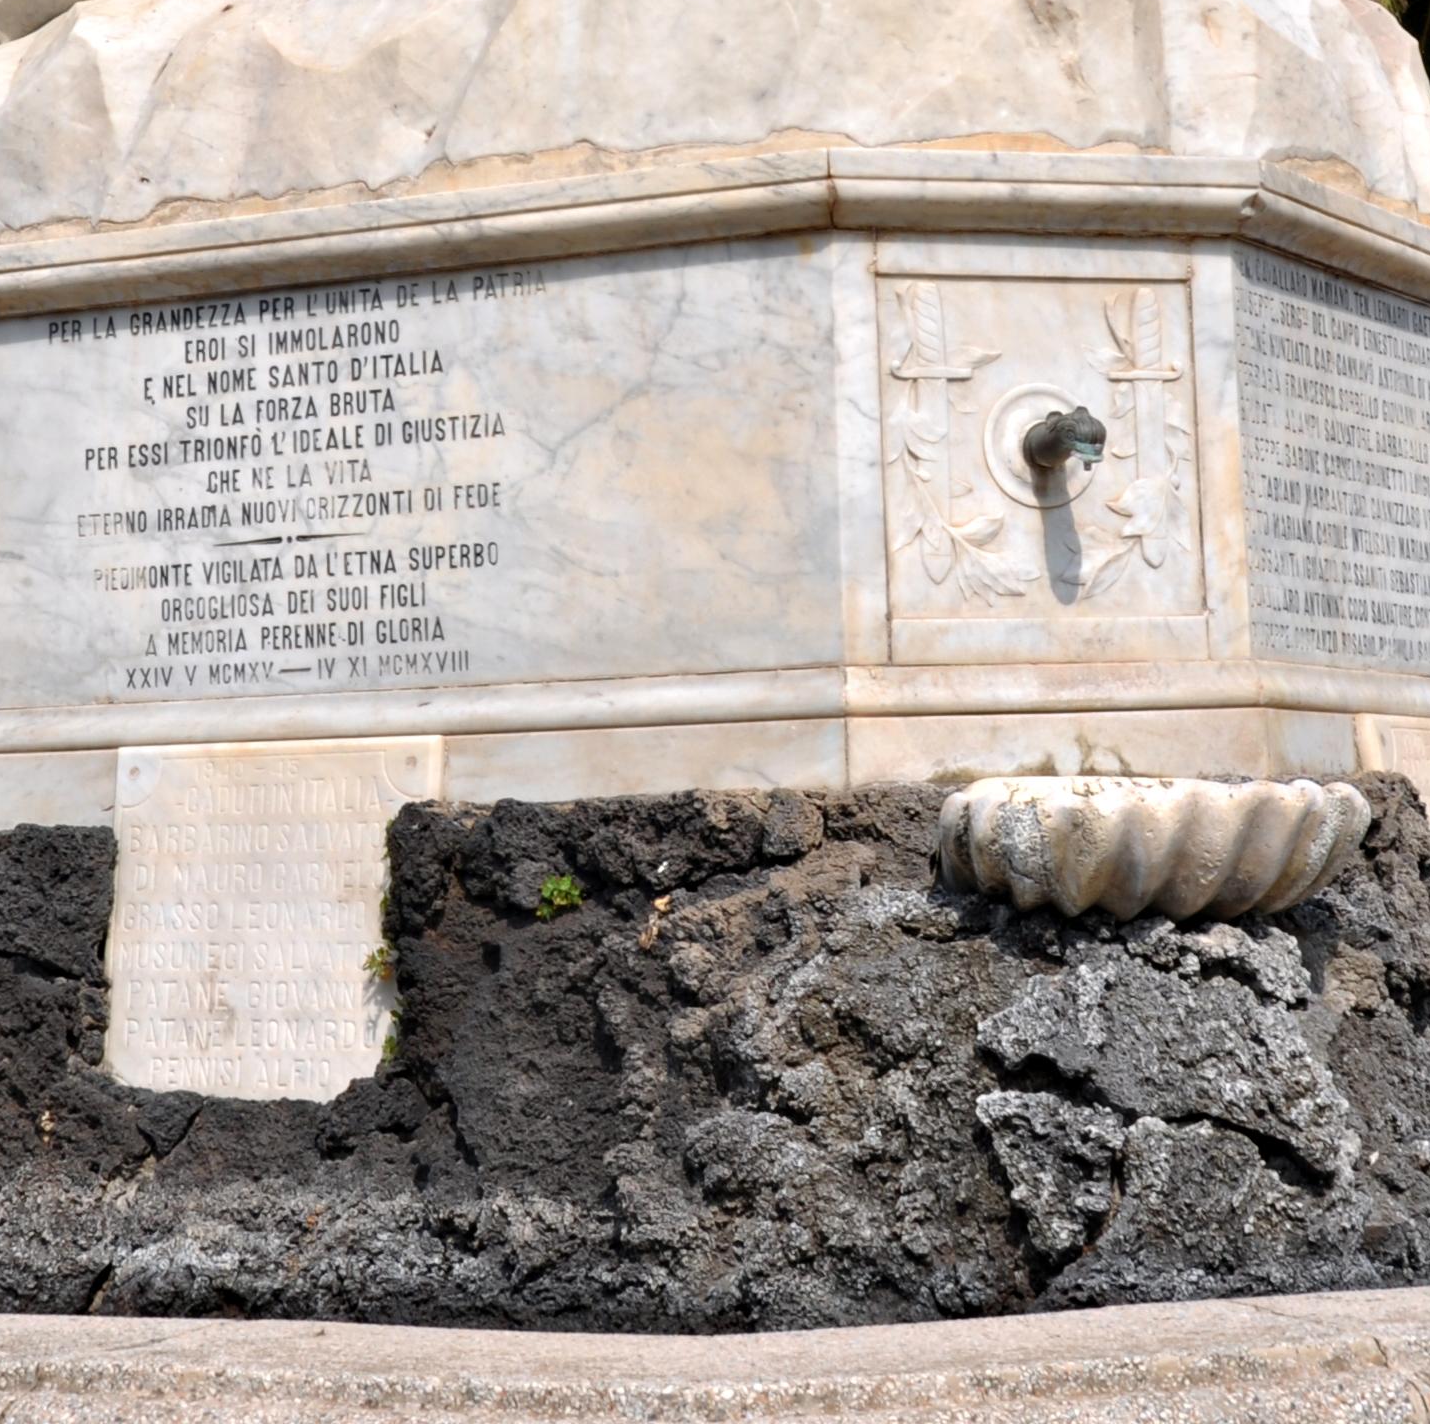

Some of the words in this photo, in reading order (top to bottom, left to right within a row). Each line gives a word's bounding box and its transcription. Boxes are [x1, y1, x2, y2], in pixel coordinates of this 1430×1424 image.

[48, 319, 82, 344] PER
[93, 316, 117, 340] LA
[130, 302, 246, 336] GRANDEZZA
[259, 296, 295, 323] PER
[396, 283, 419, 308] DE
[431, 279, 459, 305] LA
[472, 270, 547, 301] PATRIA
[185, 336, 226, 364] EROI
[238, 334, 255, 358] SI
[268, 319, 400, 356] IMMOLARONO
[163, 374, 197, 399] NEL
[207, 367, 256, 395] NOME
[268, 360, 339, 389] SANTO
[351, 349, 443, 382] D'ITALIA
[186, 405, 209, 429] SU
[221, 402, 245, 426] LA
[256, 395, 318, 424] FORZA
[330, 388, 396, 417] BRUTA
[85, 447, 118, 471] PER
[128, 442, 168, 468] ESSI
[375, 422, 392, 447] DI
[402, 412, 505, 445] GIUSTIZIA
[206, 469, 241, 494] CHE
[251, 466, 274, 490] NE
[286, 463, 313, 488] LA
[324, 458, 372, 486] VITA
[77, 510, 147, 537] ETERNO
[242, 499, 296, 527] NUOVI
[306, 490, 412, 521] ORIZZONTI
[424, 487, 442, 513] DI
[453, 482, 502, 510] FEDE
[93, 564, 193, 592] PIEDIMONTE
[202, 556, 284, 585] VIGILATA
[294, 554, 318, 579] DA
[408, 541, 499, 572] SUPERBO
[161, 592, 274, 622] ORGOGLIOSA
[288, 589, 314, 615] DEI
[327, 586, 368, 612] SUOI
[380, 582, 426, 610] FIGLI
[145, 634, 158, 657] A
[167, 628, 247, 657] MEMORIA
[261, 622, 337, 650] PERENNE
[348, 621, 364, 647] DI
[376, 616, 445, 645] GLORIA
[126, 667, 174, 689] XXIV
[185, 665, 197, 687] V
[209, 661, 274, 685] MCMXV
[318, 657, 335, 680] IV
[348, 656, 367, 678] XI
[379, 649, 470, 677] MCMXVIII
[126, 822, 270, 855] BARBARINO
[133, 862, 156, 893] DI
[172, 861, 264, 894] MAURO
[122, 901, 220, 932] GRASSO
[229, 900, 367, 931] LEONARDO
[117, 941, 245, 973] MUSUMECI
[232, 1016, 377, 1050] LEONARDO
[148, 1055, 243, 1089] PENNISI
[254, 1056, 332, 1090] ALFIO
